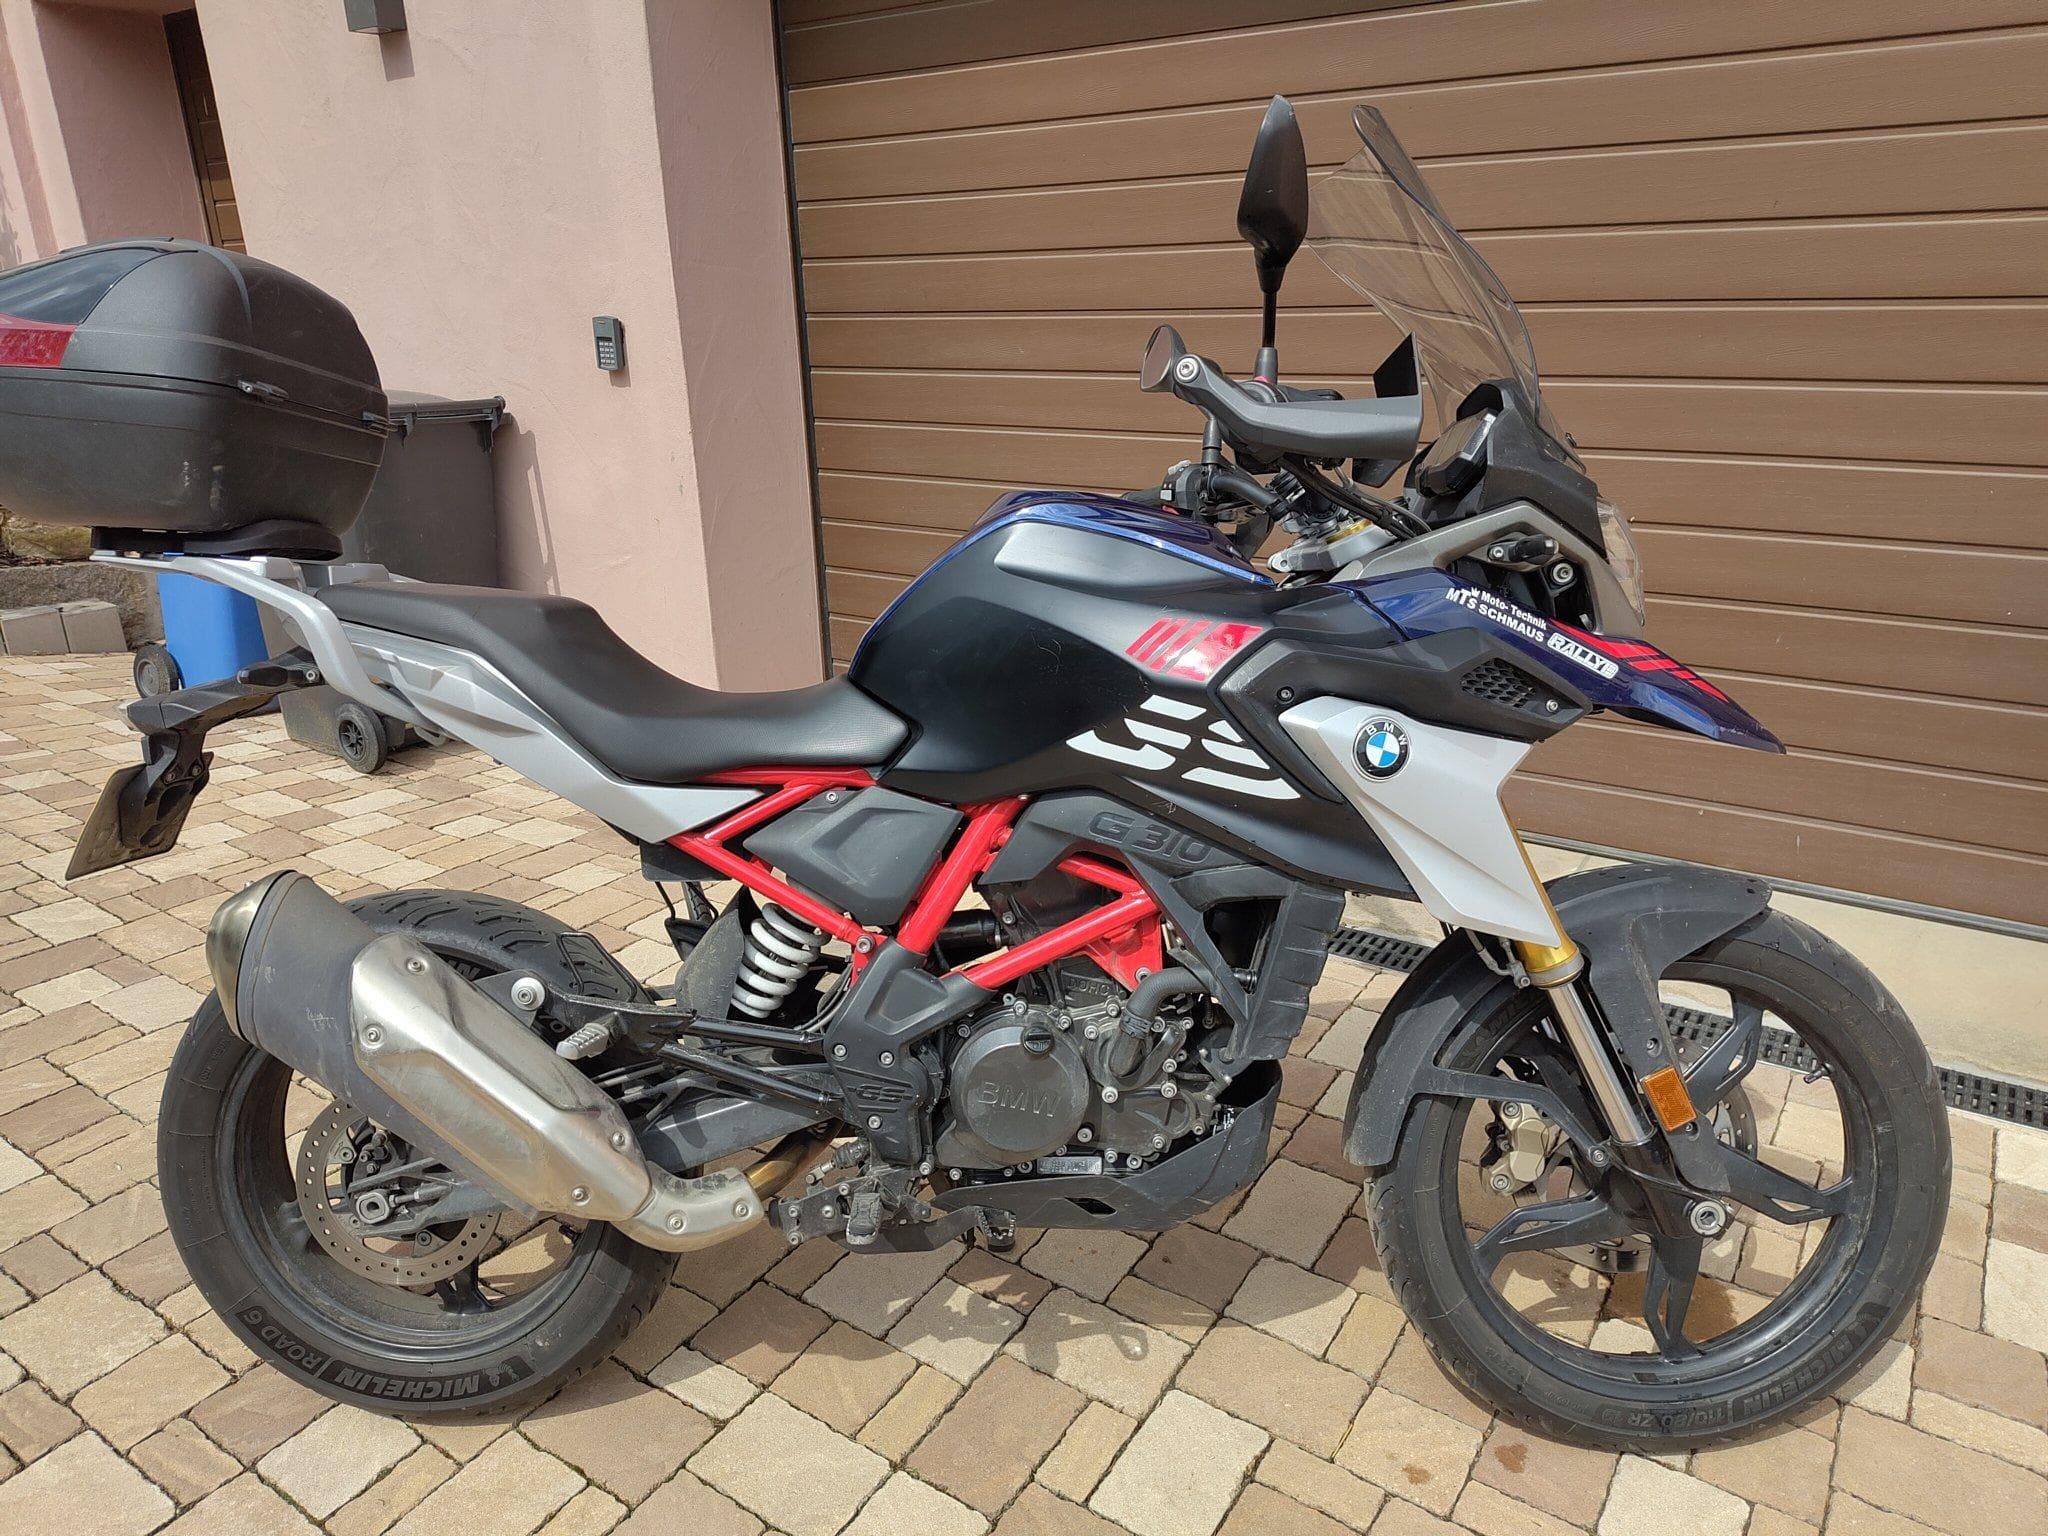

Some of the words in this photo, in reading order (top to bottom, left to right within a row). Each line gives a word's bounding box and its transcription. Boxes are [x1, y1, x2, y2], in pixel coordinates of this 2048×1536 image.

[1445, 587, 1479, 611] MTS
[1478, 604, 1545, 643] SCHMAUS
[1510, 605, 1548, 630] Technik
[1364, 721, 1408, 746] BMW
[1088, 811, 1136, 844] G
[1131, 822, 1214, 864] 310
[977, 1081, 1062, 1118] BMW
[244, 1308, 264, 1326] 6
[261, 1325, 317, 1370] ROAD
[335, 1366, 480, 1399] MICHELIN
